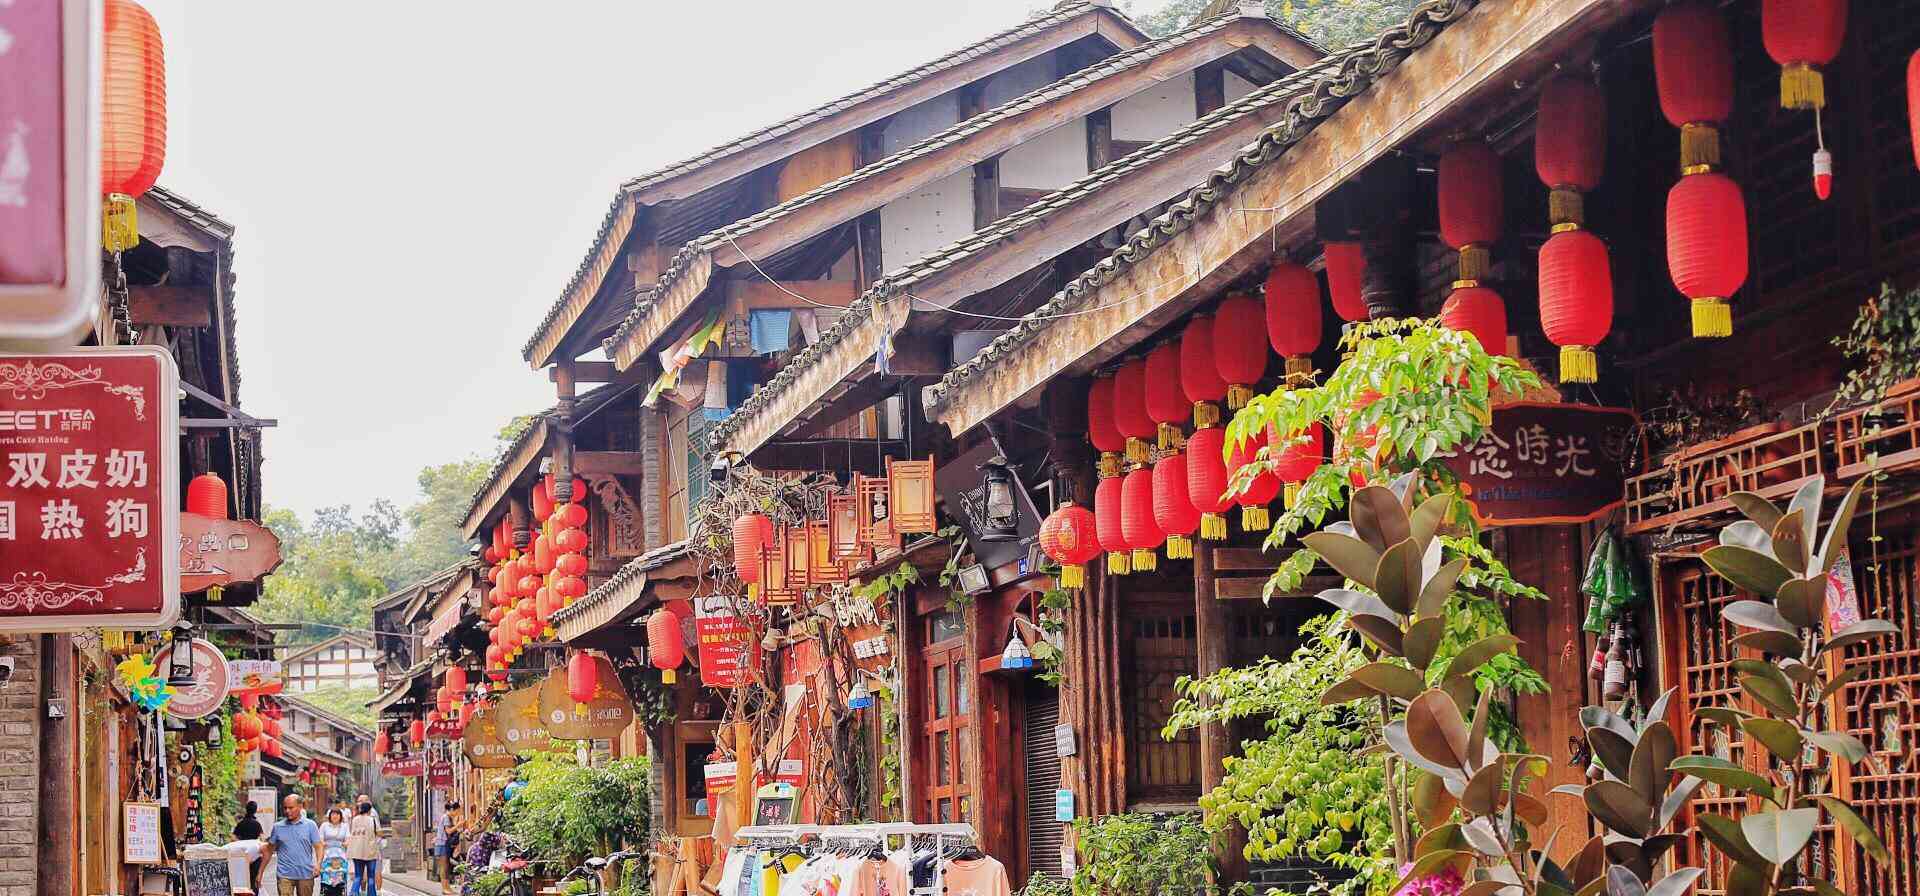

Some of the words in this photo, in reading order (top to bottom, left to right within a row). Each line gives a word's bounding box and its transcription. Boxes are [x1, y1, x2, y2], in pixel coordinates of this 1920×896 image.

[59, 409, 95, 420] TEA
[6, 448, 148, 489] 双皮奶
